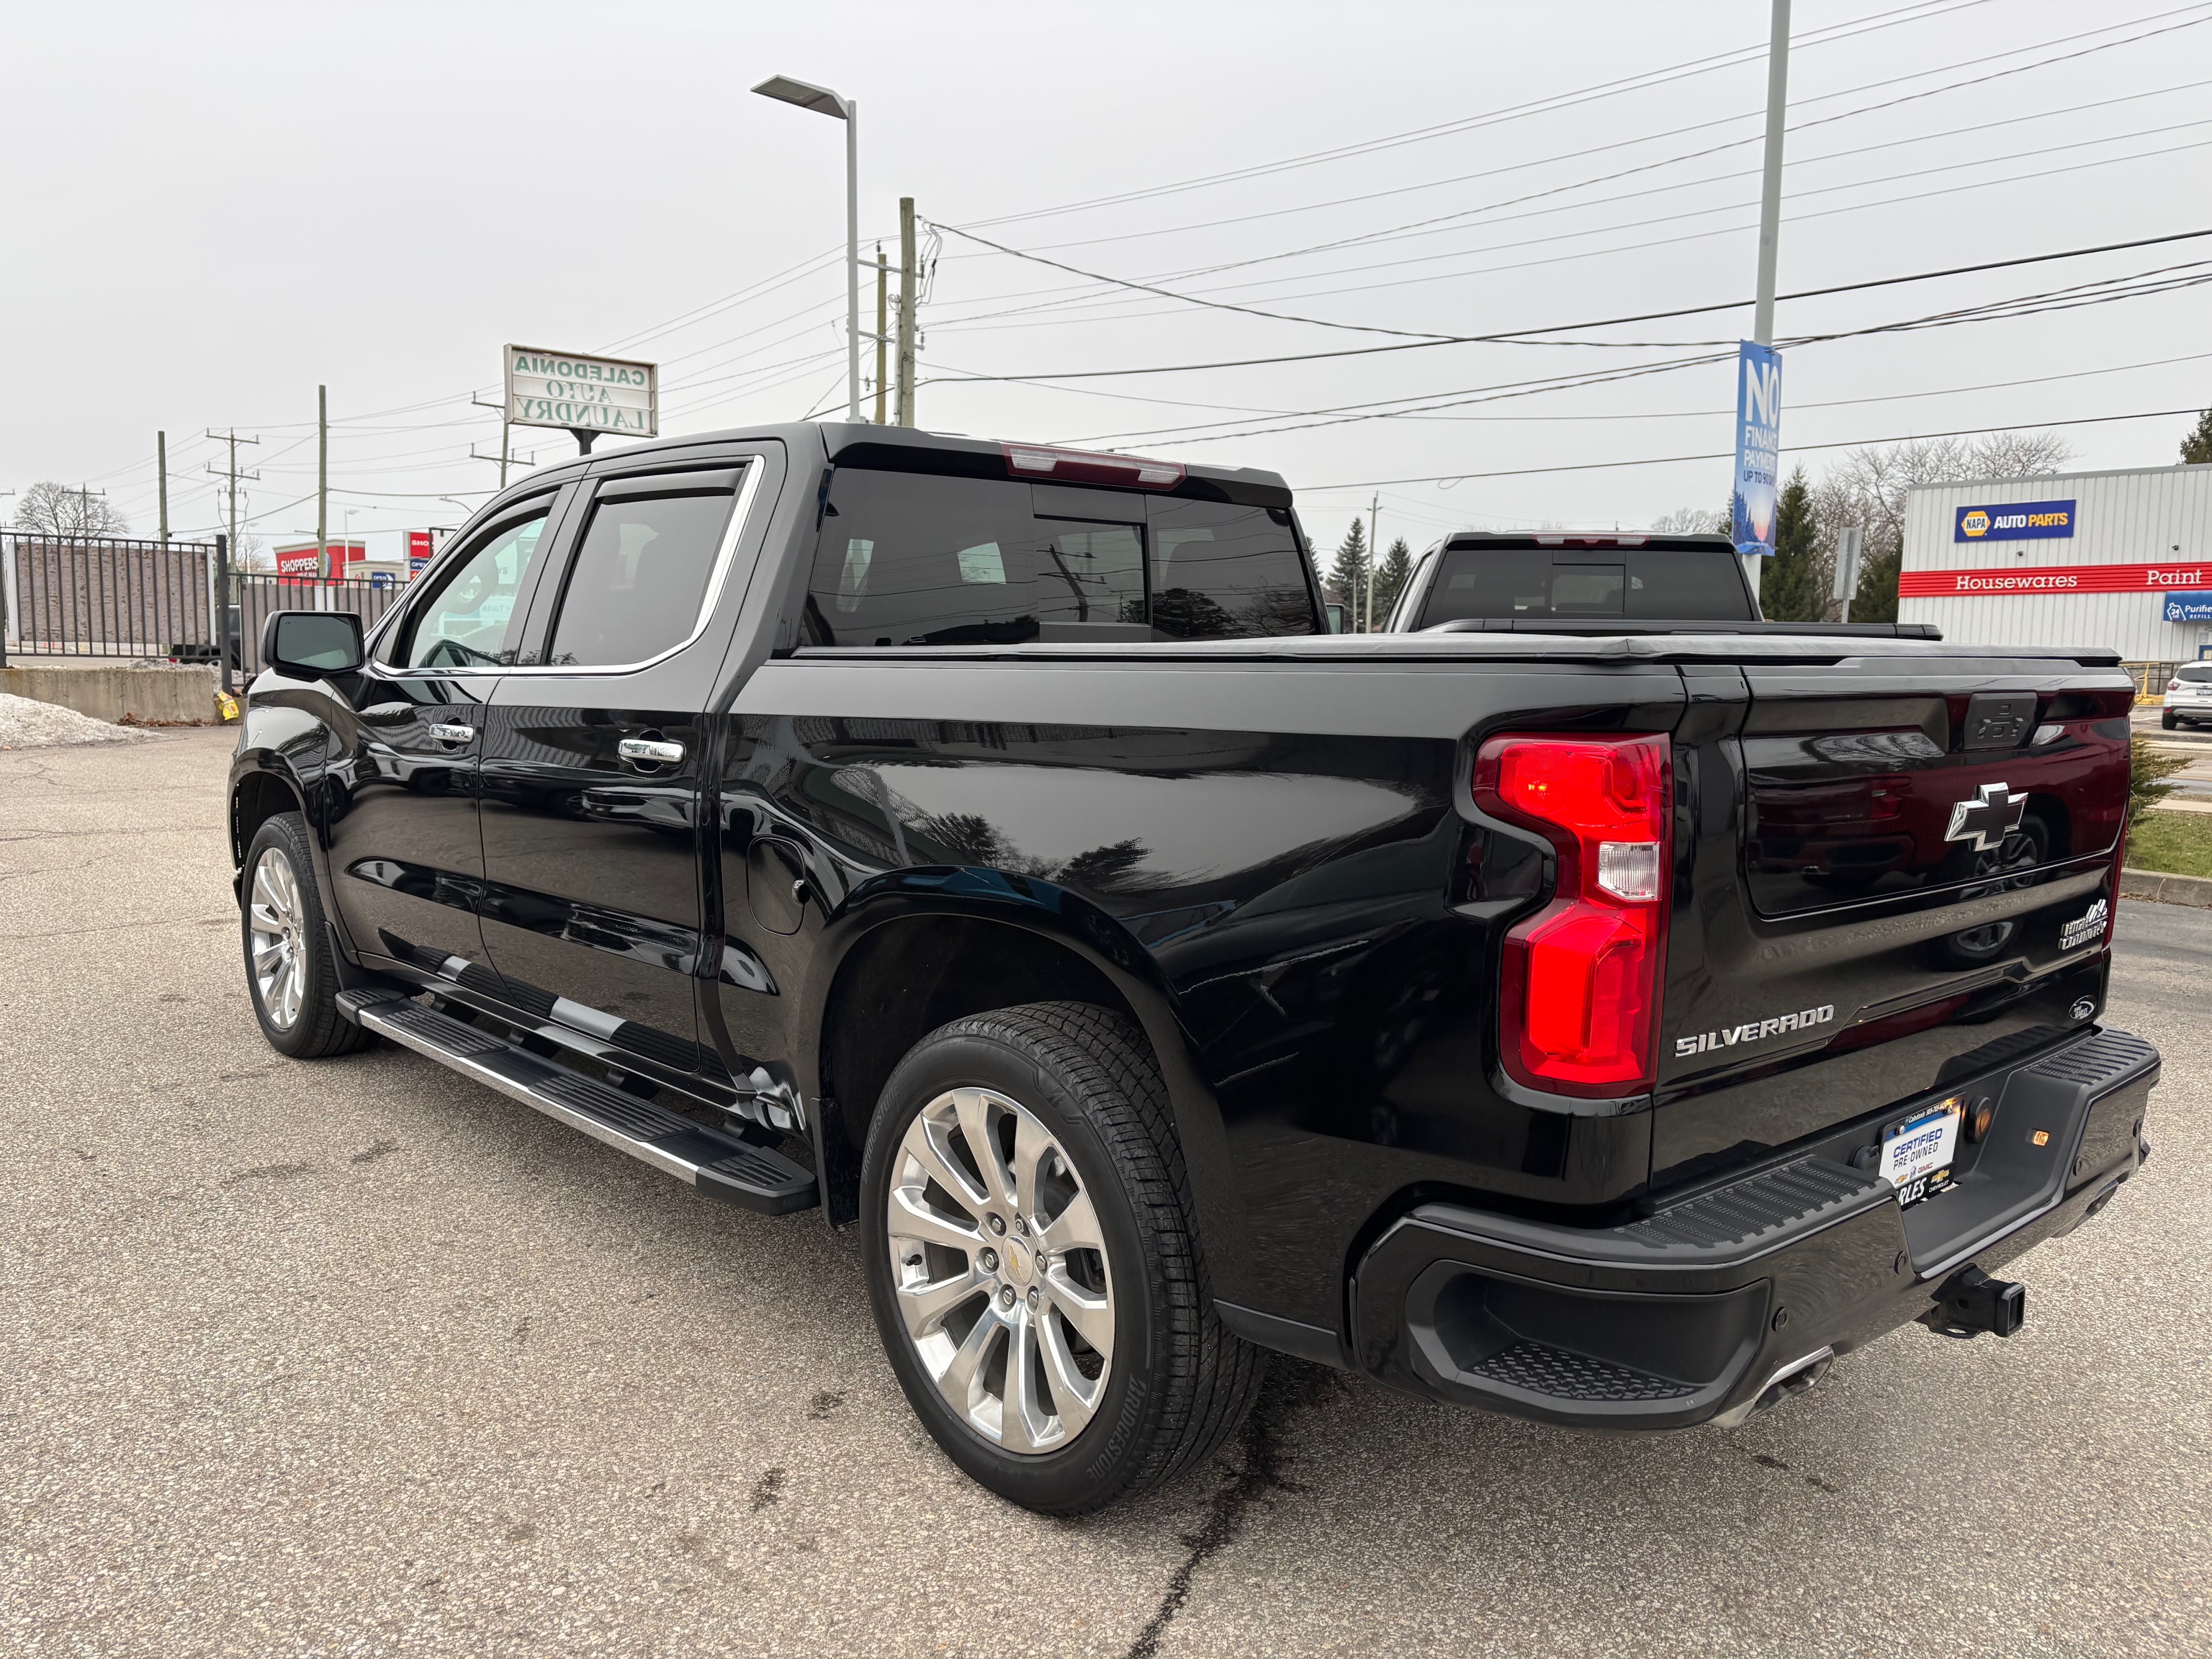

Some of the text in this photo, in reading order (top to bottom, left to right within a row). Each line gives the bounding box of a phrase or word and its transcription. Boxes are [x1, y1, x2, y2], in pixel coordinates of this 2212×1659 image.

[1745, 359, 1779, 428] NO
[1743, 469, 1753, 482] UP
[1754, 471, 1762, 484] TO
[1966, 512, 2069, 529] NAPA AUTO PARTS
[281, 556, 319, 573] SHOPPERS
[1955, 575, 2078, 590] Housewares
[2146, 569, 2203, 585] Paint
[1674, 1004, 1835, 1058] SILVERADO
[1893, 1128, 1943, 1159] CERTIFIED
[1894, 1142, 1938, 1170] PRE-OWNED
[1917, 1162, 1933, 1174] GMC
[1897, 1177, 1928, 1207] RLES
[1928, 1179, 1950, 1193] CHEVROLET
[1086, 1372, 1147, 1480] BRIDGESTONE
